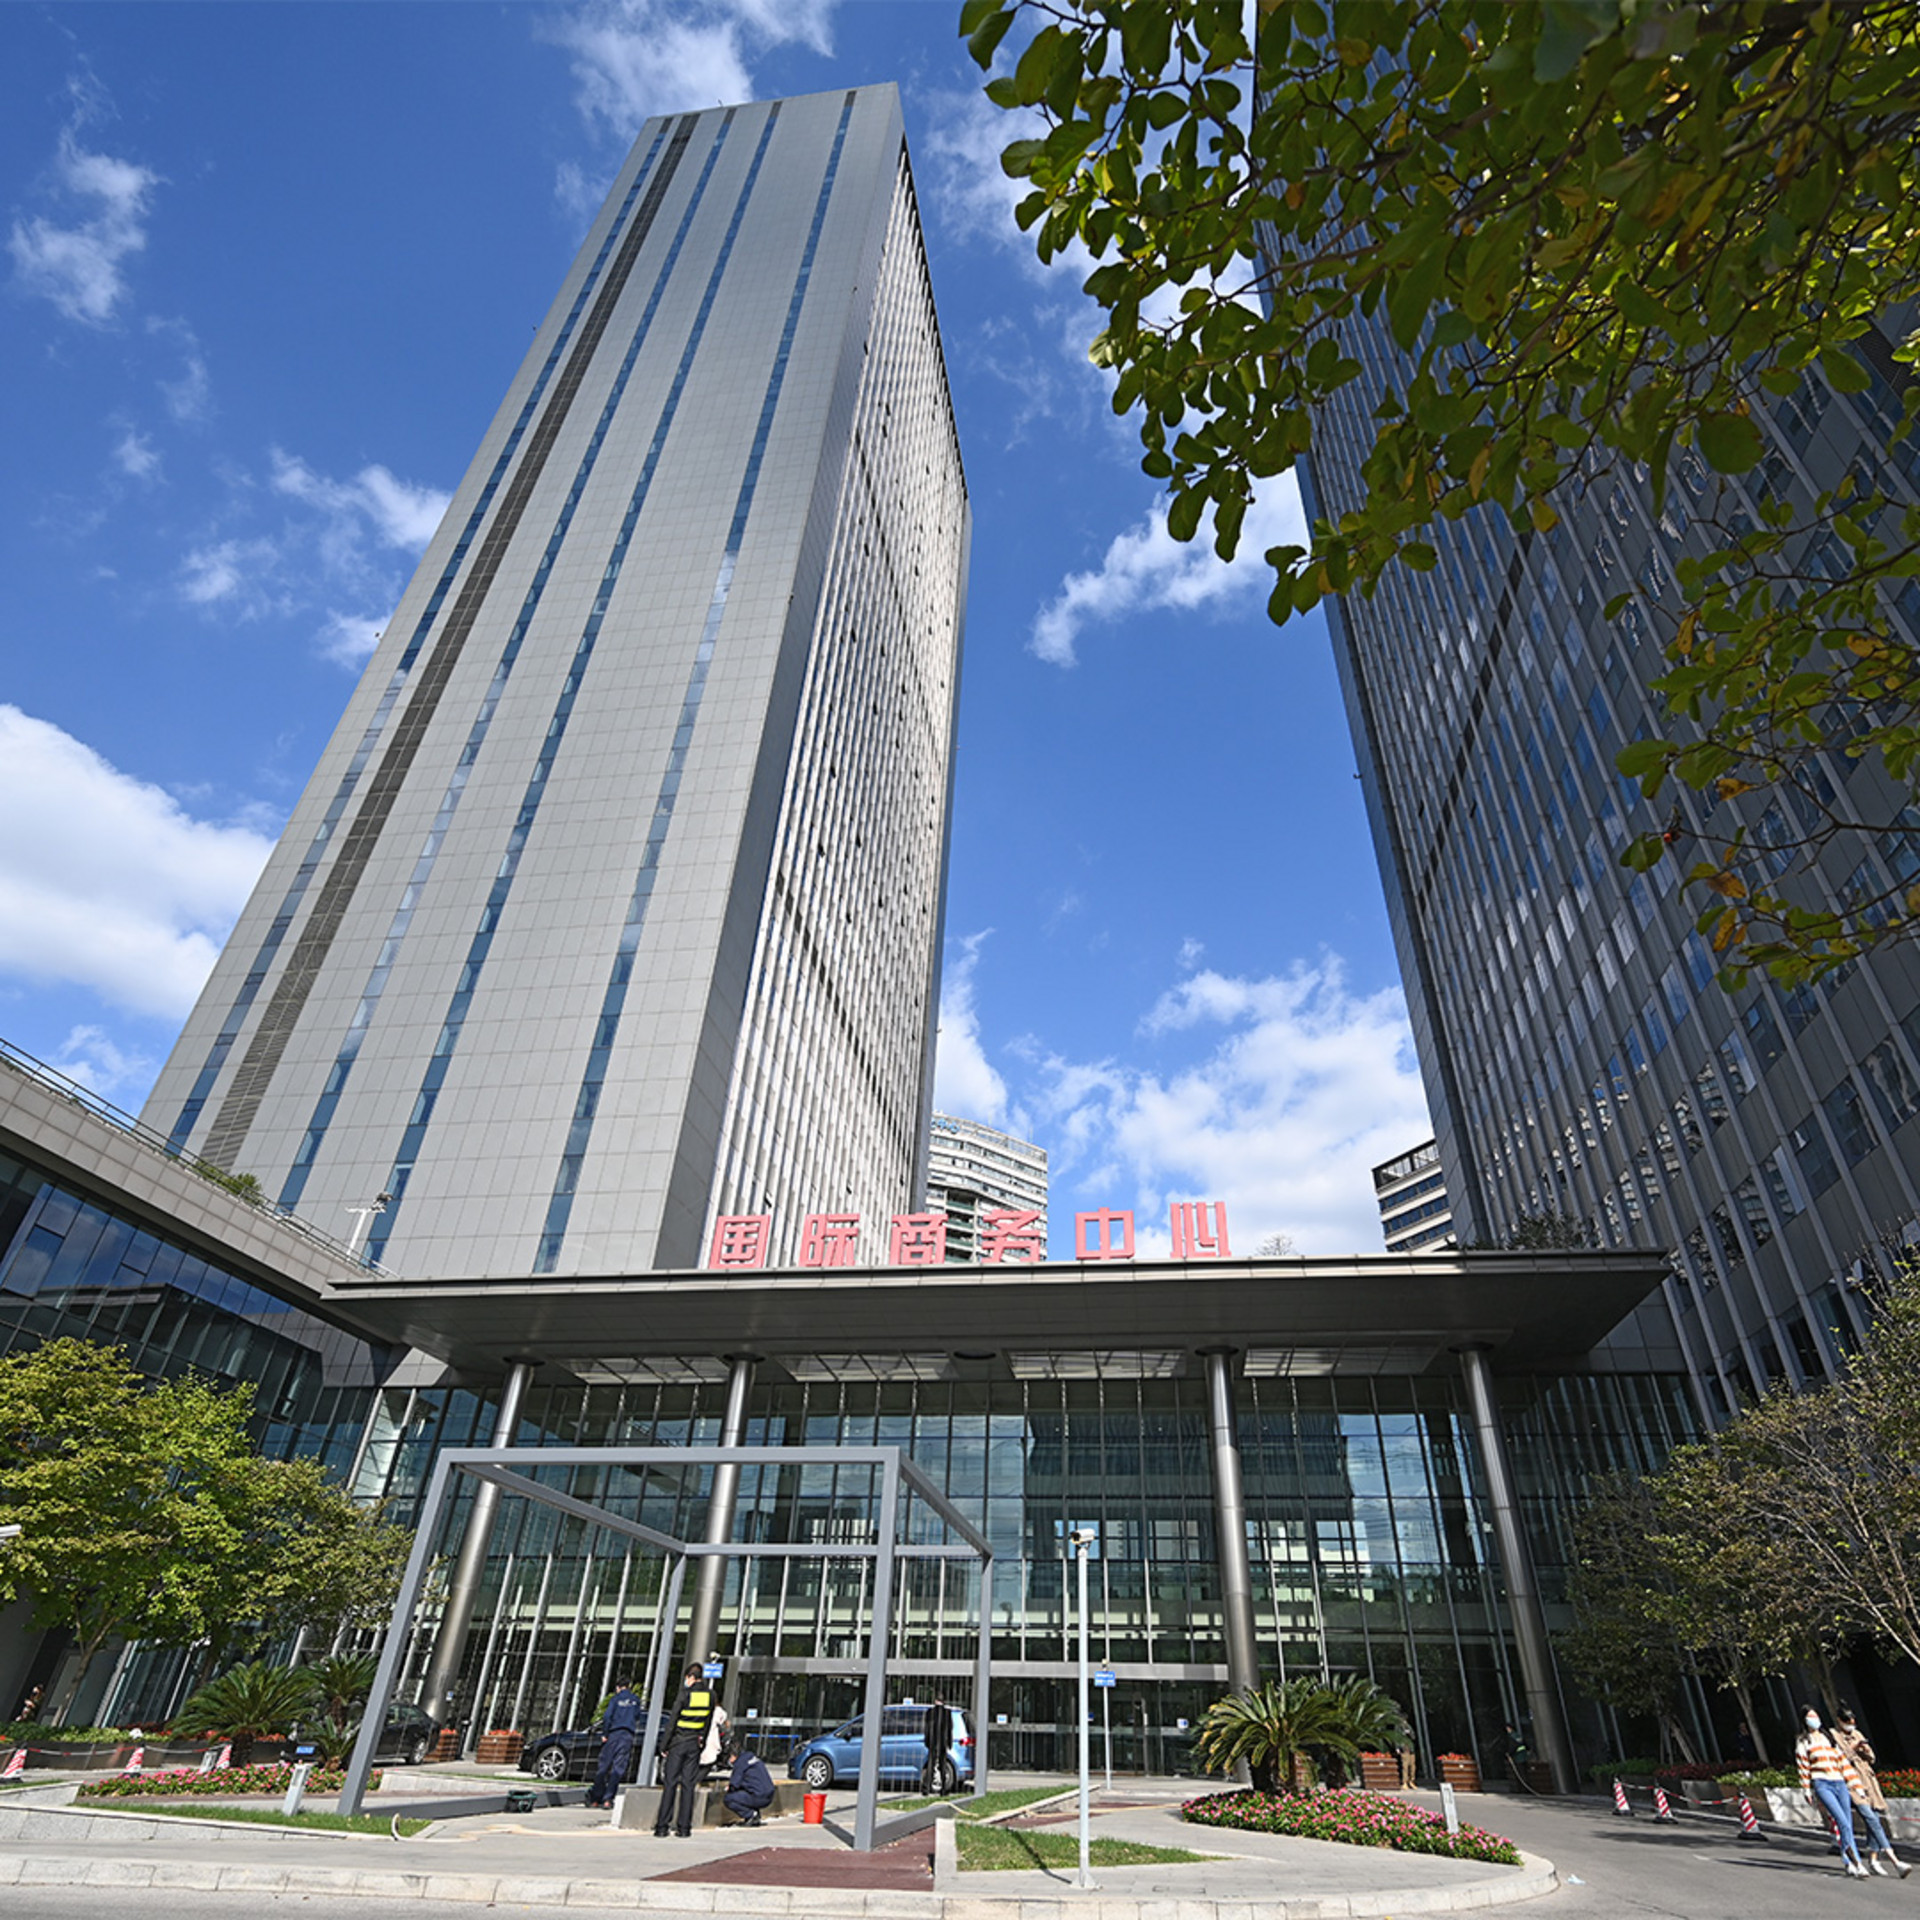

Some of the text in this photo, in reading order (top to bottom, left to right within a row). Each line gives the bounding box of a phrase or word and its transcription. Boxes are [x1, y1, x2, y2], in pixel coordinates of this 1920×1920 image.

[709, 1202, 1231, 1269] 国际商务中心
